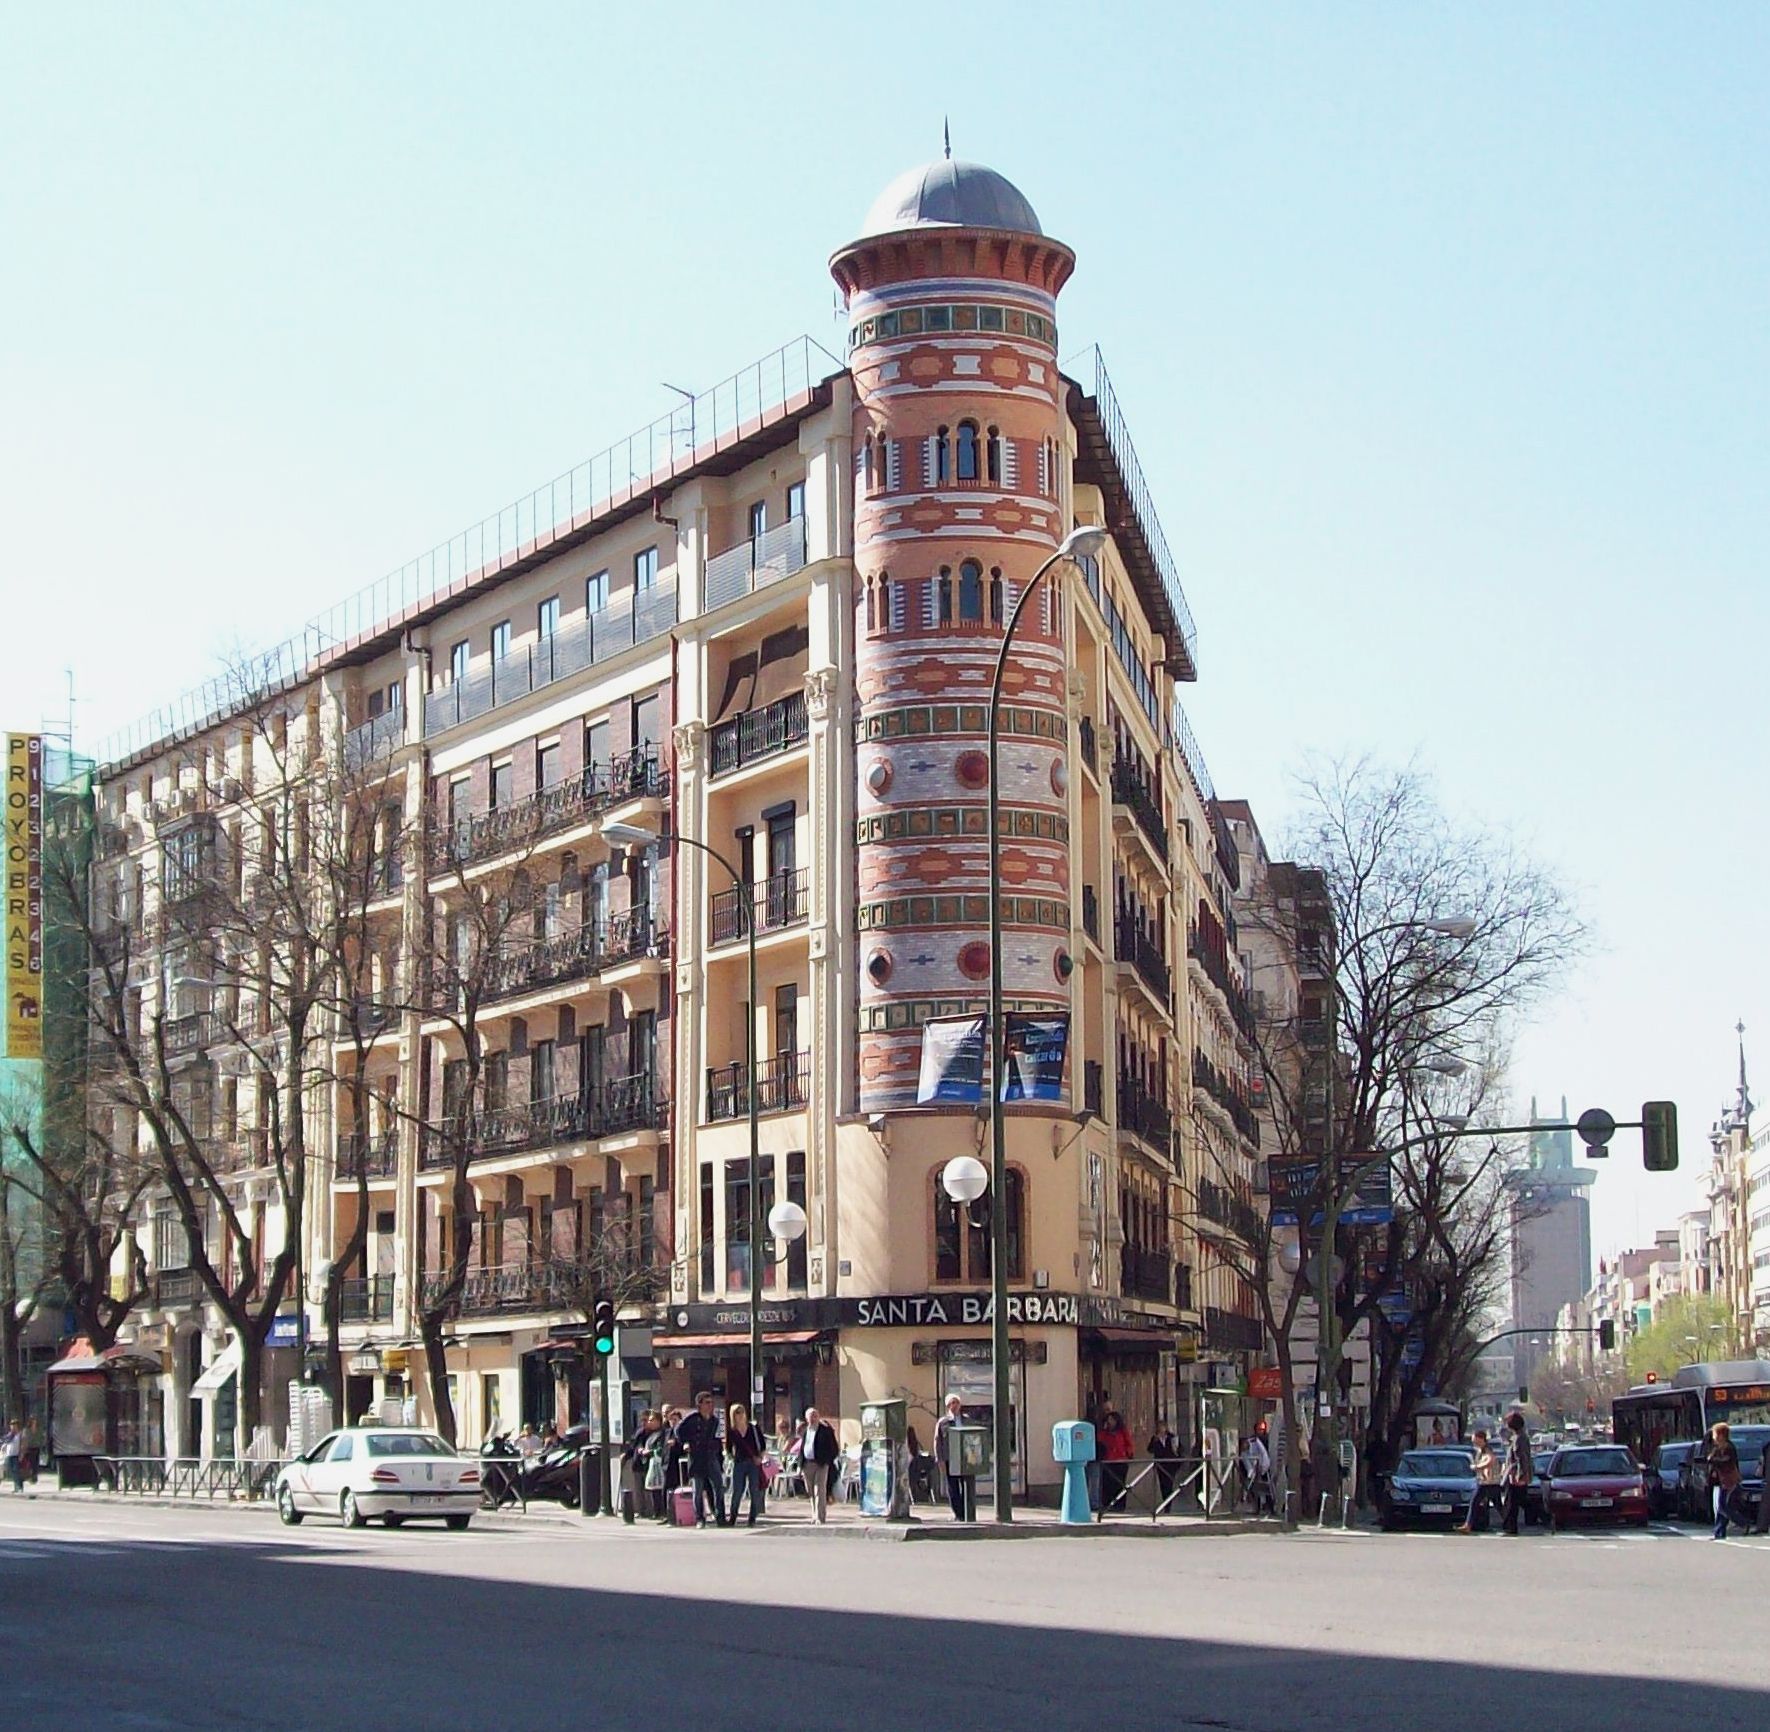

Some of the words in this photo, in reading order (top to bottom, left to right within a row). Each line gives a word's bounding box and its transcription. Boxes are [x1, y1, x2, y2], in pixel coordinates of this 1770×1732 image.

[9, 739, 26, 970] PROYOBRAS
[858, 1298, 948, 1325] SANTA
[962, 1297, 1078, 1323] BARBARA
